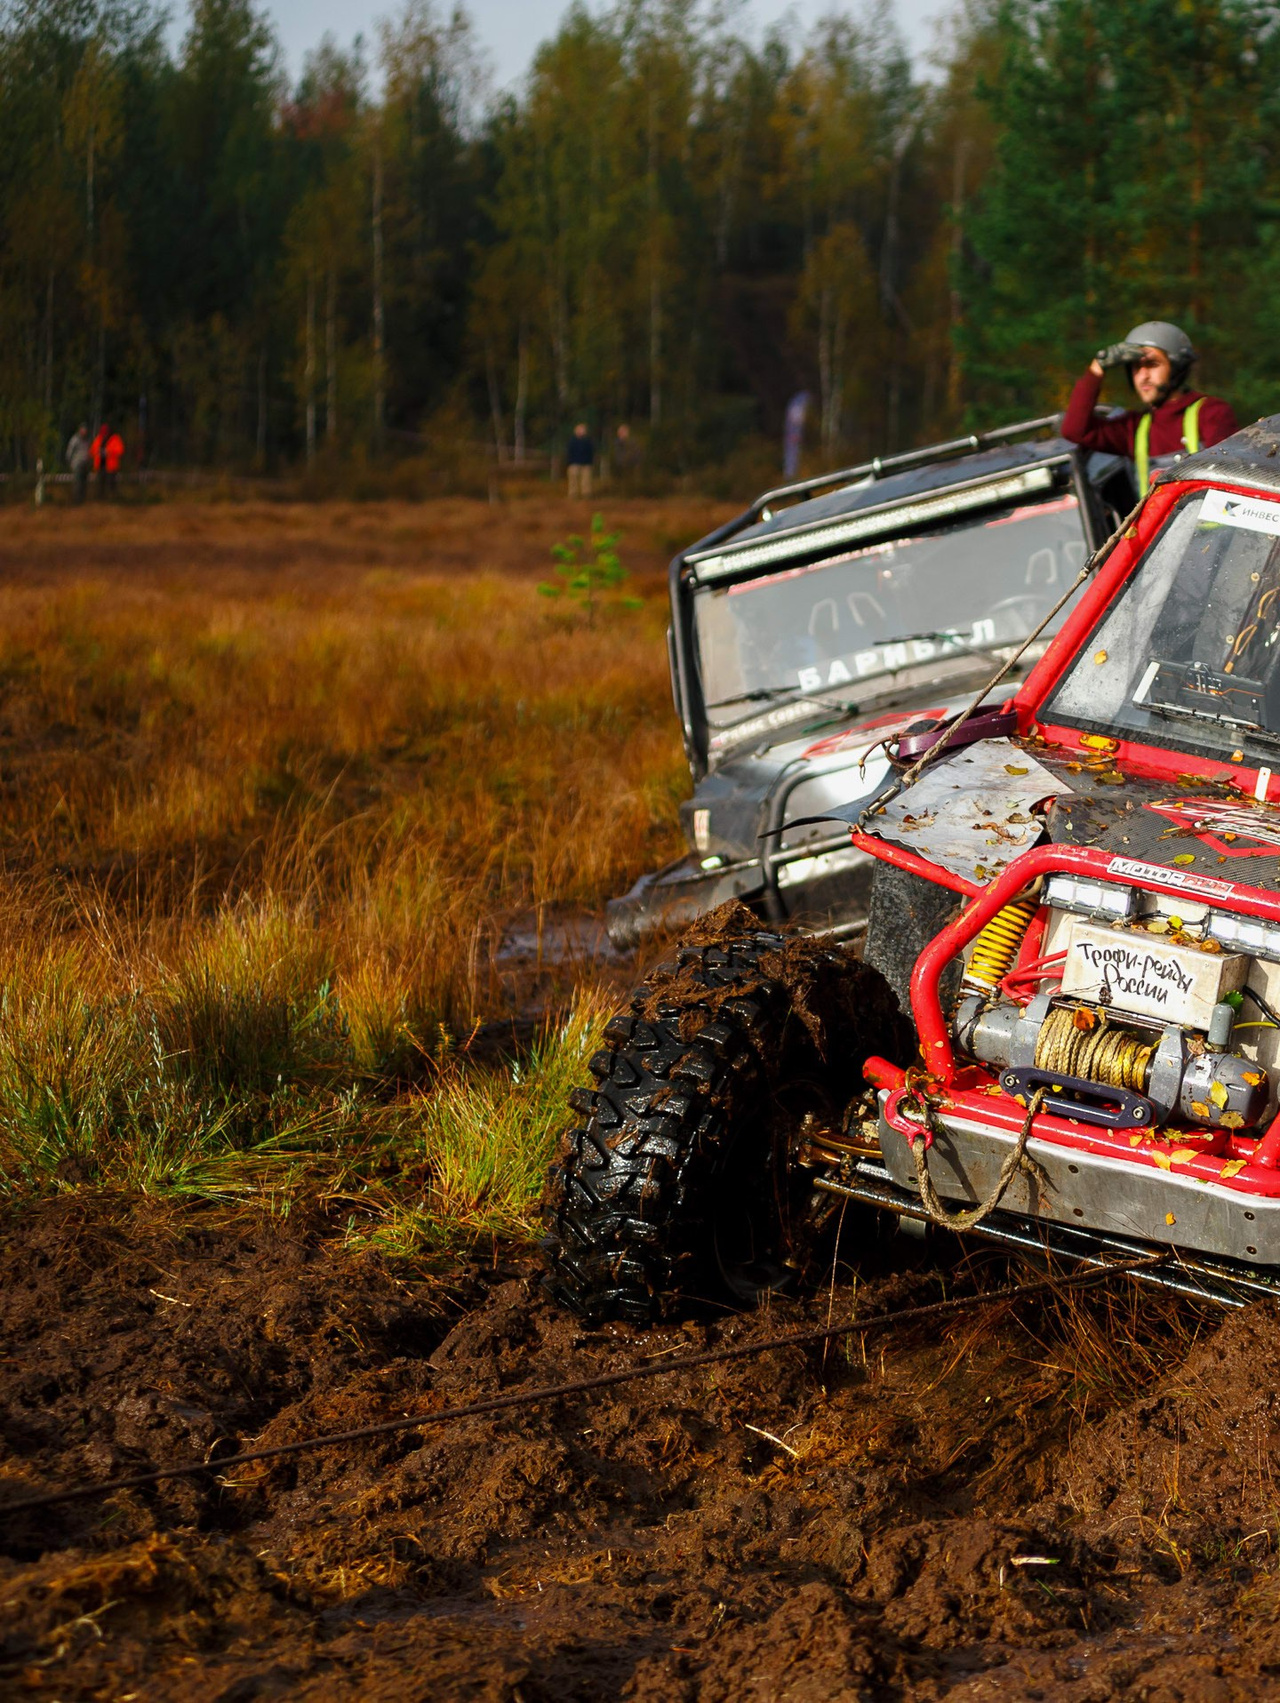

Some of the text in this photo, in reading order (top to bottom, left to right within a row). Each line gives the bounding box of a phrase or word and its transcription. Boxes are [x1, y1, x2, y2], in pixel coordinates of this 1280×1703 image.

[797, 618, 996, 695] БАРИБАЛ
[1076, 943, 1193, 994] Трофи-рейды
[1102, 962, 1168, 1005] России
